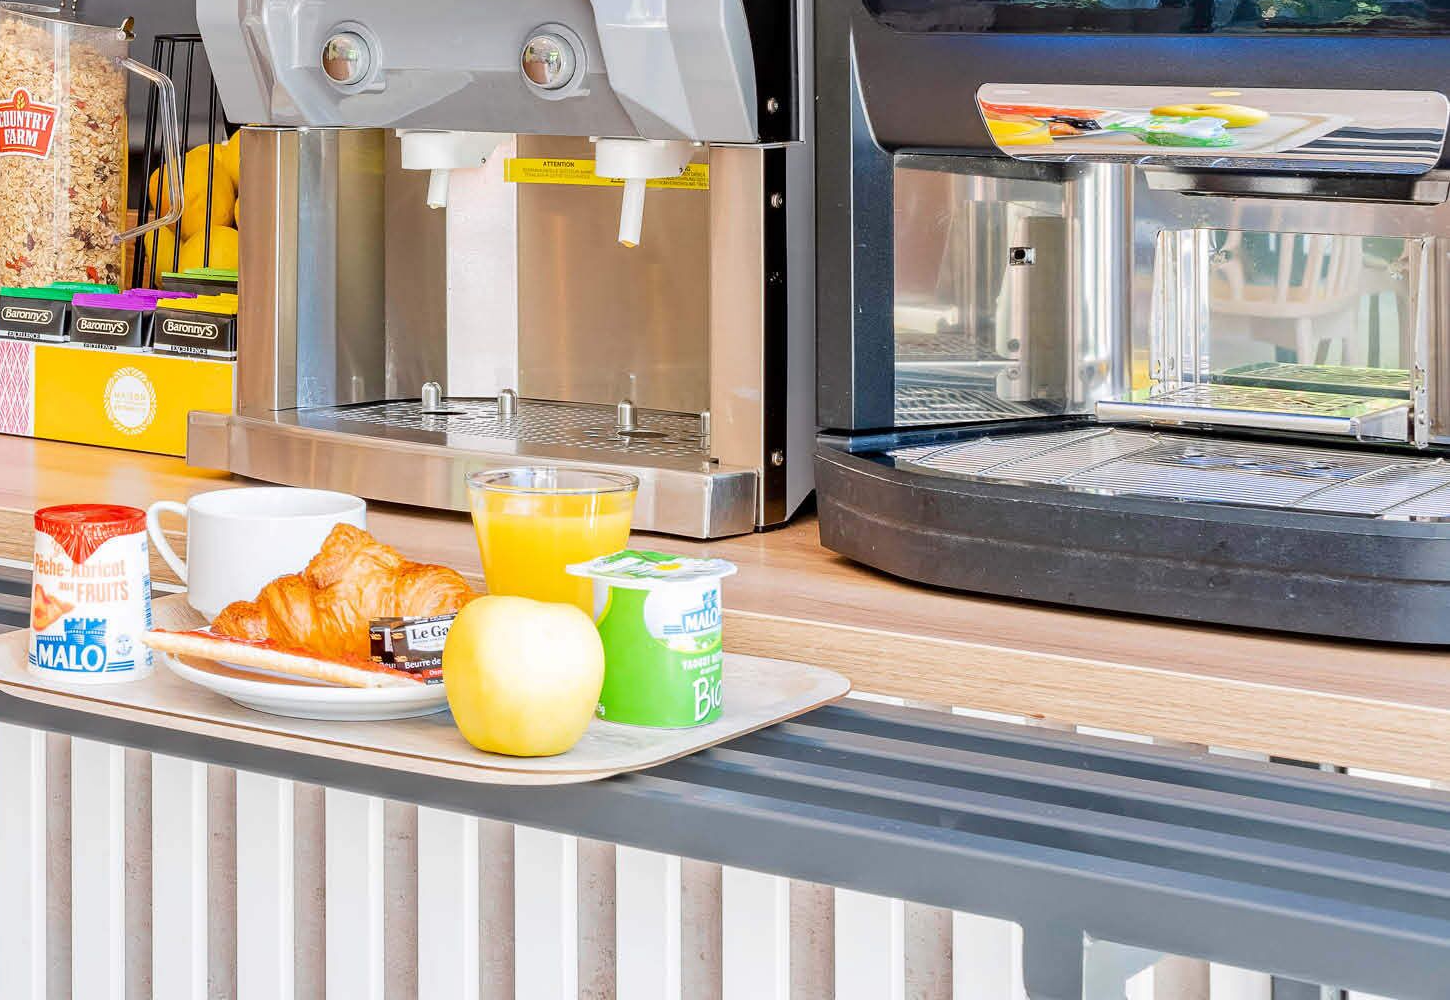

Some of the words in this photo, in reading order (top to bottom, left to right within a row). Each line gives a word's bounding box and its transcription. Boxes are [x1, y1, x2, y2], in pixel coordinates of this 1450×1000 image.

[4, 129, 38, 147] FARM
[542, 160, 575, 168] ATTENTION
[7, 331, 41, 339] EXCELLENCE
[83, 343, 117, 351] EXCELLENCE
[171, 345, 207, 355] EXCELLENCE
[35, 552, 126, 578] Pêche-Abricot
[77, 580, 129, 603] FRUITS
[686, 607, 718, 633] MALO
[412, 628, 428, 640] Le
[431, 625, 449, 637] Ga
[38, 643, 105, 671] MALO
[405, 660, 431, 669] Beurre
[431, 657, 441, 666] de
